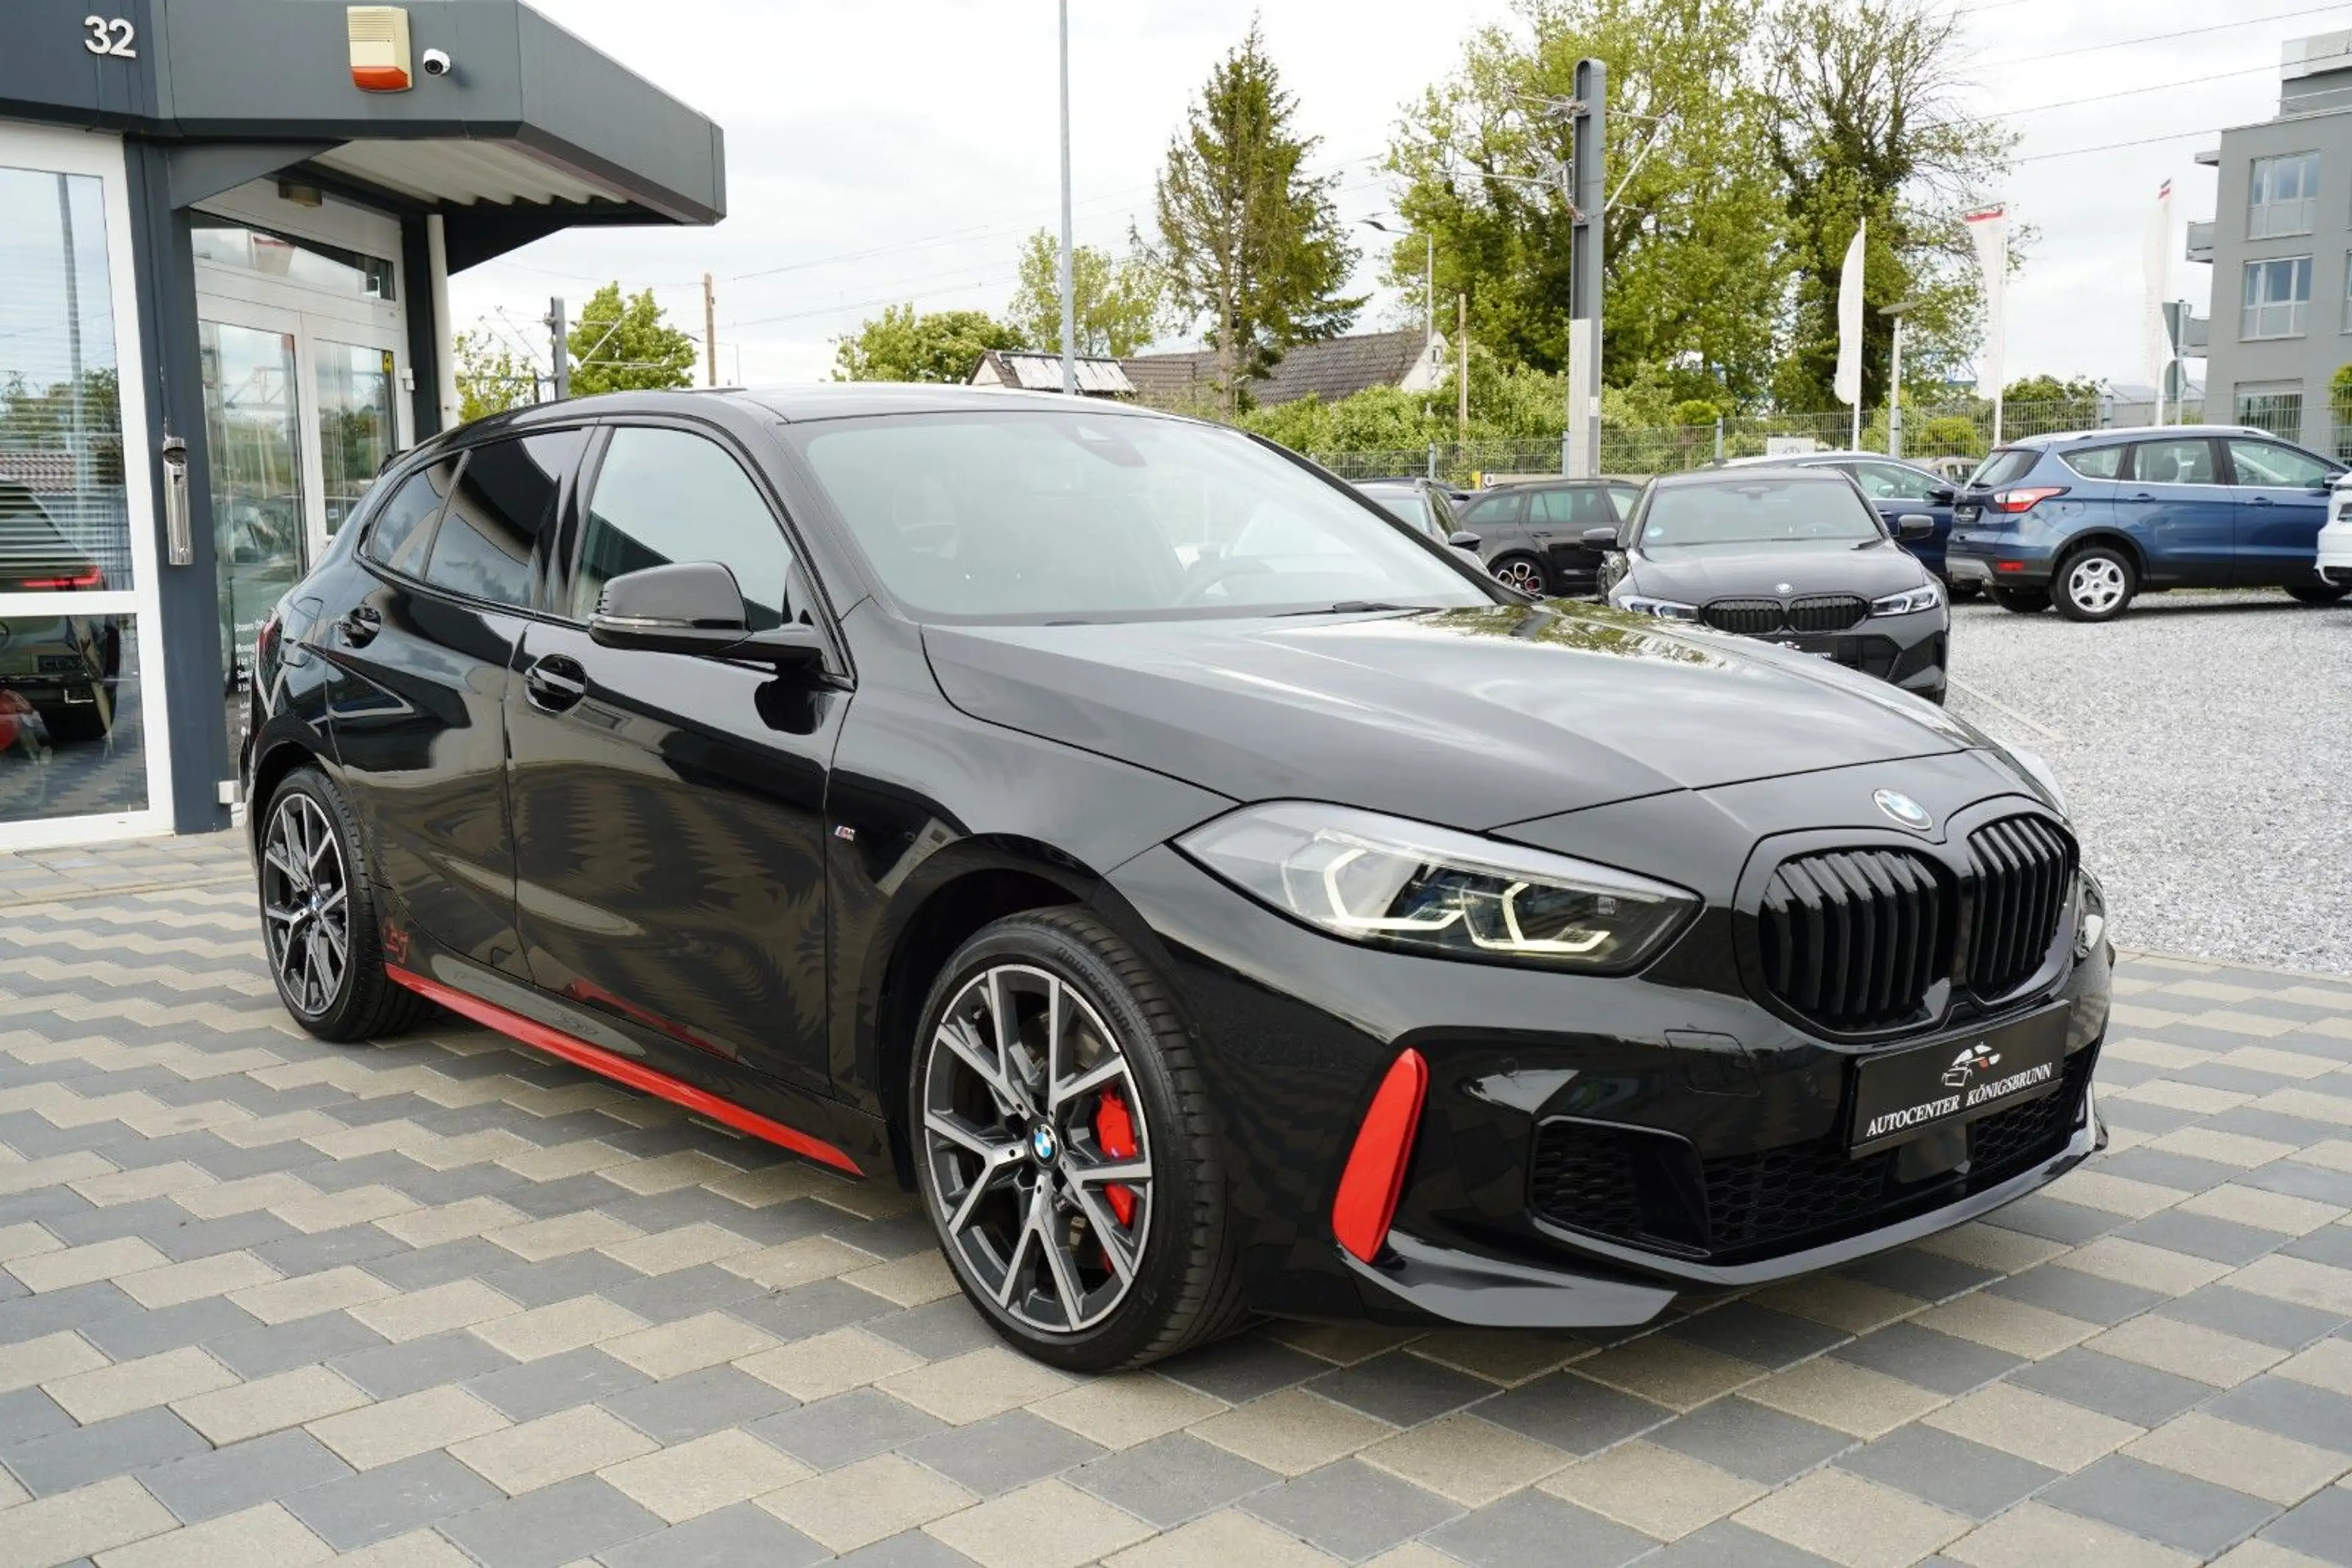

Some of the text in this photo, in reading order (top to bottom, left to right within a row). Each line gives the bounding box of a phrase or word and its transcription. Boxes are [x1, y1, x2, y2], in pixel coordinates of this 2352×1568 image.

[85, 15, 136, 58] 32
[1866, 1062, 2052, 1137] AUTOCENTER KÖNIGSBRUNN
